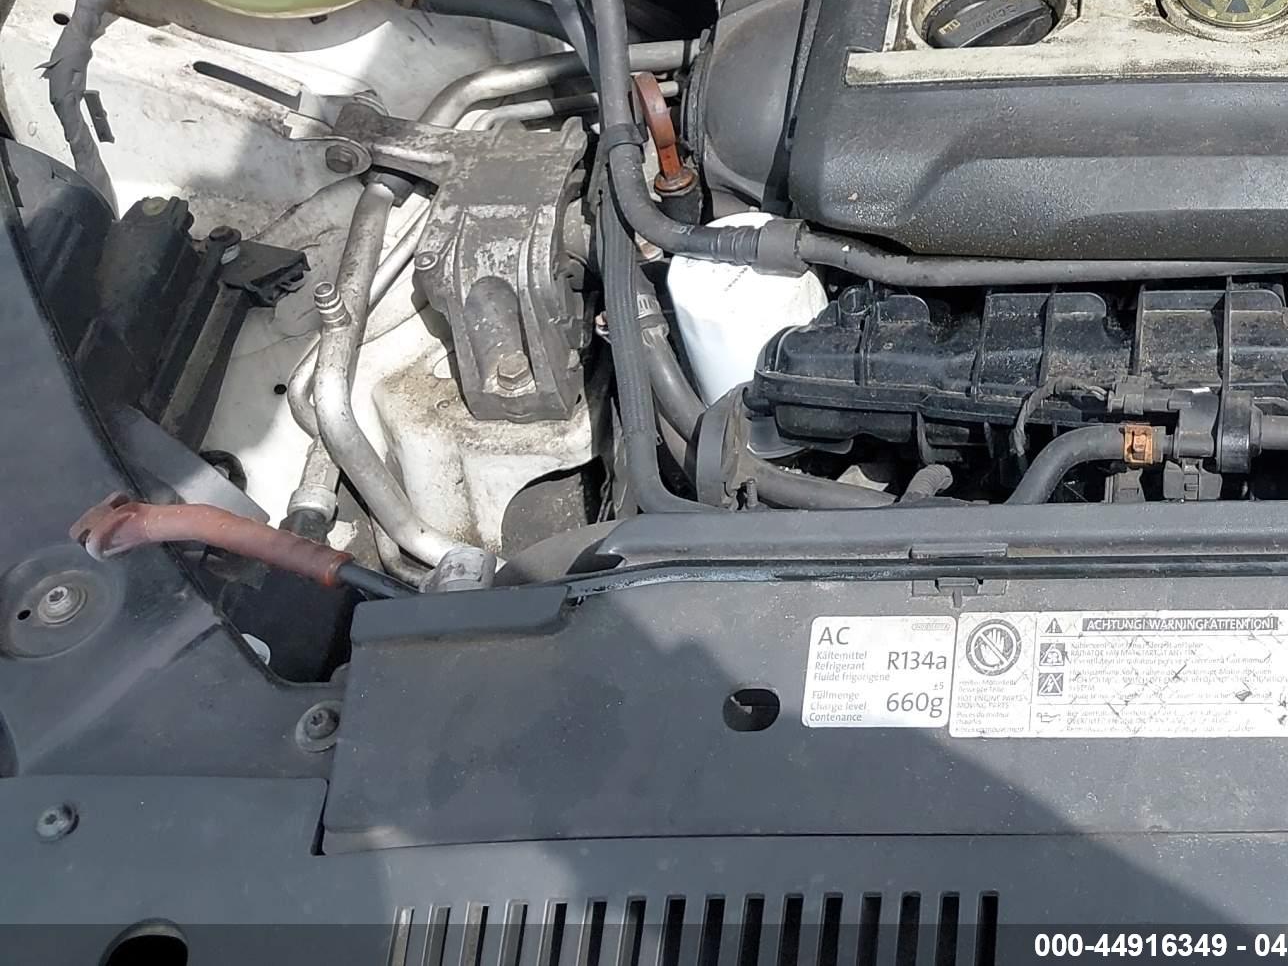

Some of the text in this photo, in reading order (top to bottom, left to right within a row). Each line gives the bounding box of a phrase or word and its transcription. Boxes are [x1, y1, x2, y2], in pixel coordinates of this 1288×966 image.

[1086, 618, 1146, 631] ACHTUNG!
[818, 627, 850, 645] AC
[816, 650, 947, 670] Kältemittel R134a
[814, 661, 865, 673] Refrigerant
[813, 672, 840, 681] Fluide
[810, 701, 867, 714] Charge level
[811, 690, 944, 719] Füllmenge 660g
[809, 712, 863, 722] Contenance
